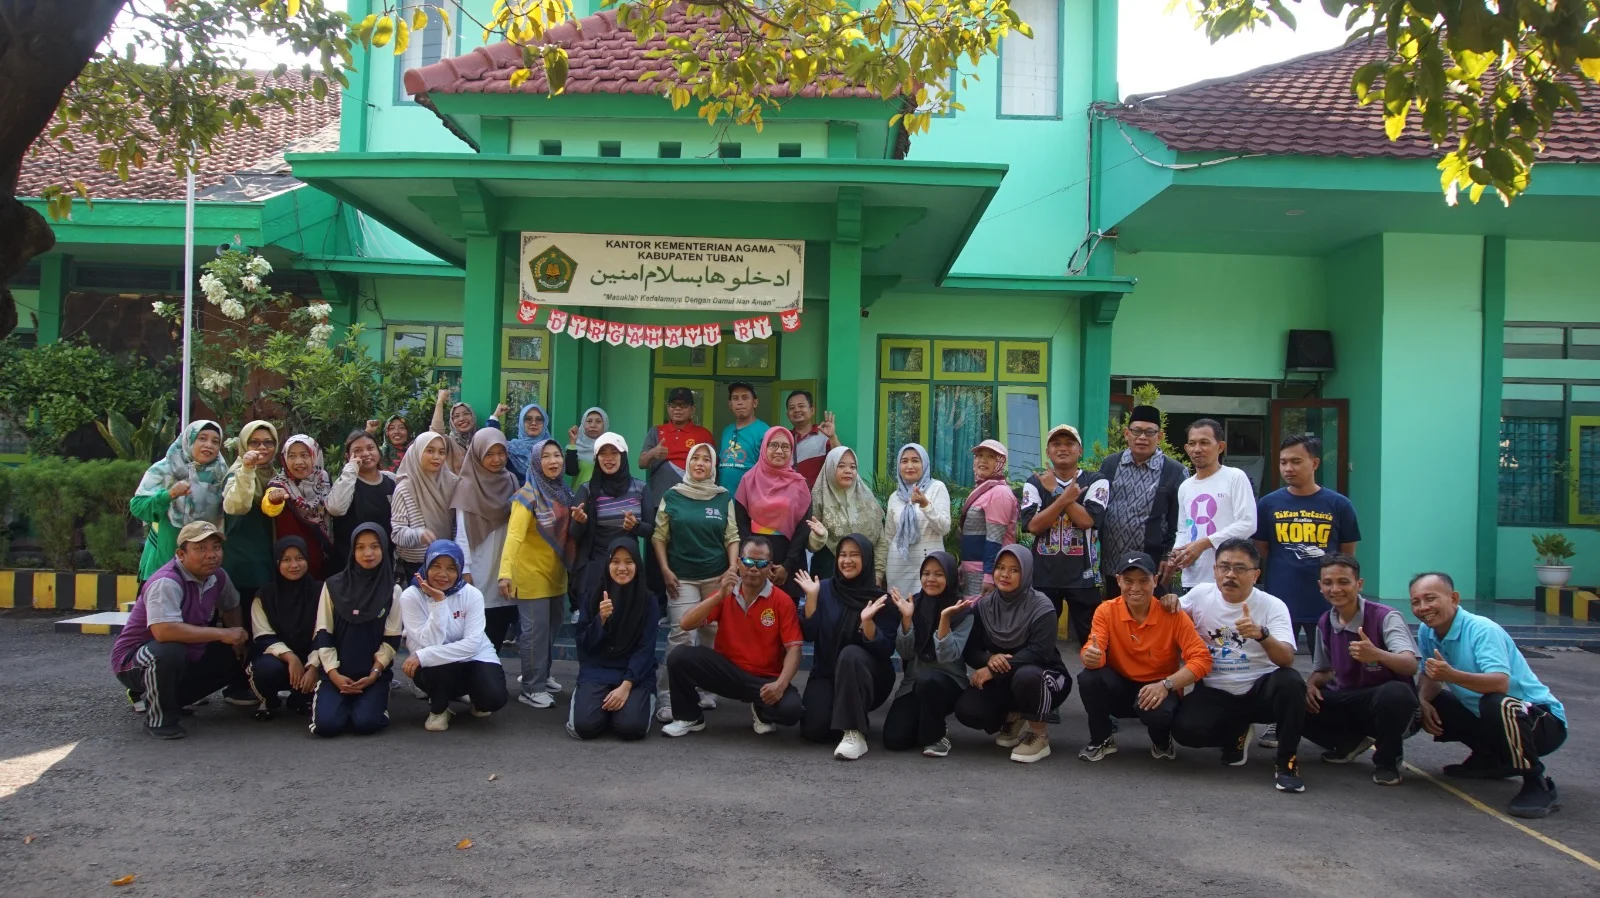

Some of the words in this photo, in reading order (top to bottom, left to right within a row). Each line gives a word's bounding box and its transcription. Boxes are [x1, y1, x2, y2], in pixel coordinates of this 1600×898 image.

[606, 240, 651, 250] KANTOR
[654, 241, 733, 252] KEMENTERIAN
[735, 244, 776, 254] AGAMA
[638, 251, 703, 261] KABUPATEN
[707, 253, 744, 262] TUBAN
[550, 316, 717, 346] DIRGAHAYU
[1275, 522, 1332, 544] KORG
